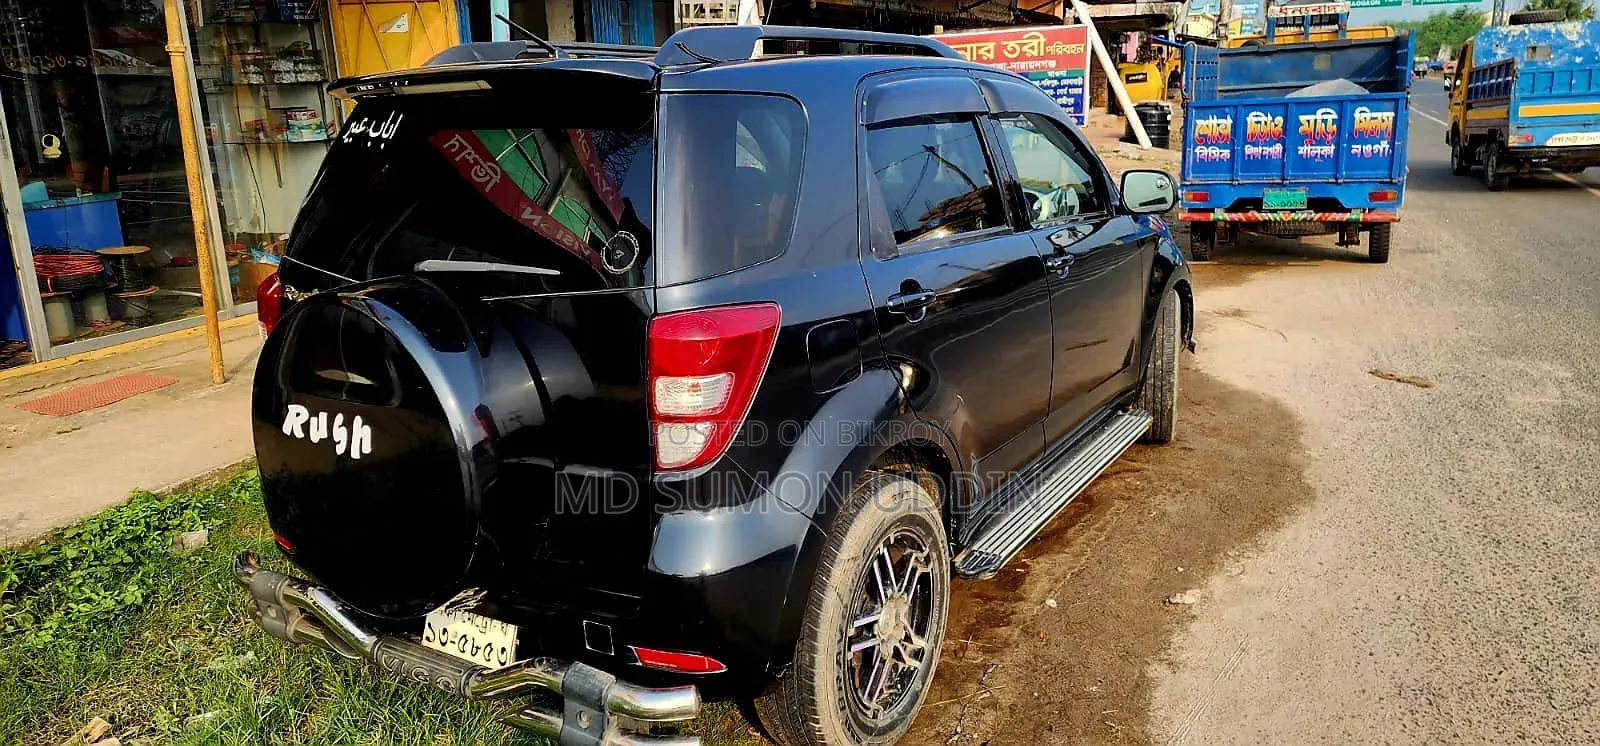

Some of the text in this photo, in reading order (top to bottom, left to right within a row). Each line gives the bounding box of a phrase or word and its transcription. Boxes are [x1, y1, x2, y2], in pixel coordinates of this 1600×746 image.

[1001, 31, 1047, 59] তরী
[1298, 107, 1338, 145] মুড়ি
[1194, 145, 1231, 162] বিসিক
[425, 621, 508, 667] ১৩-৫৮৫৩
